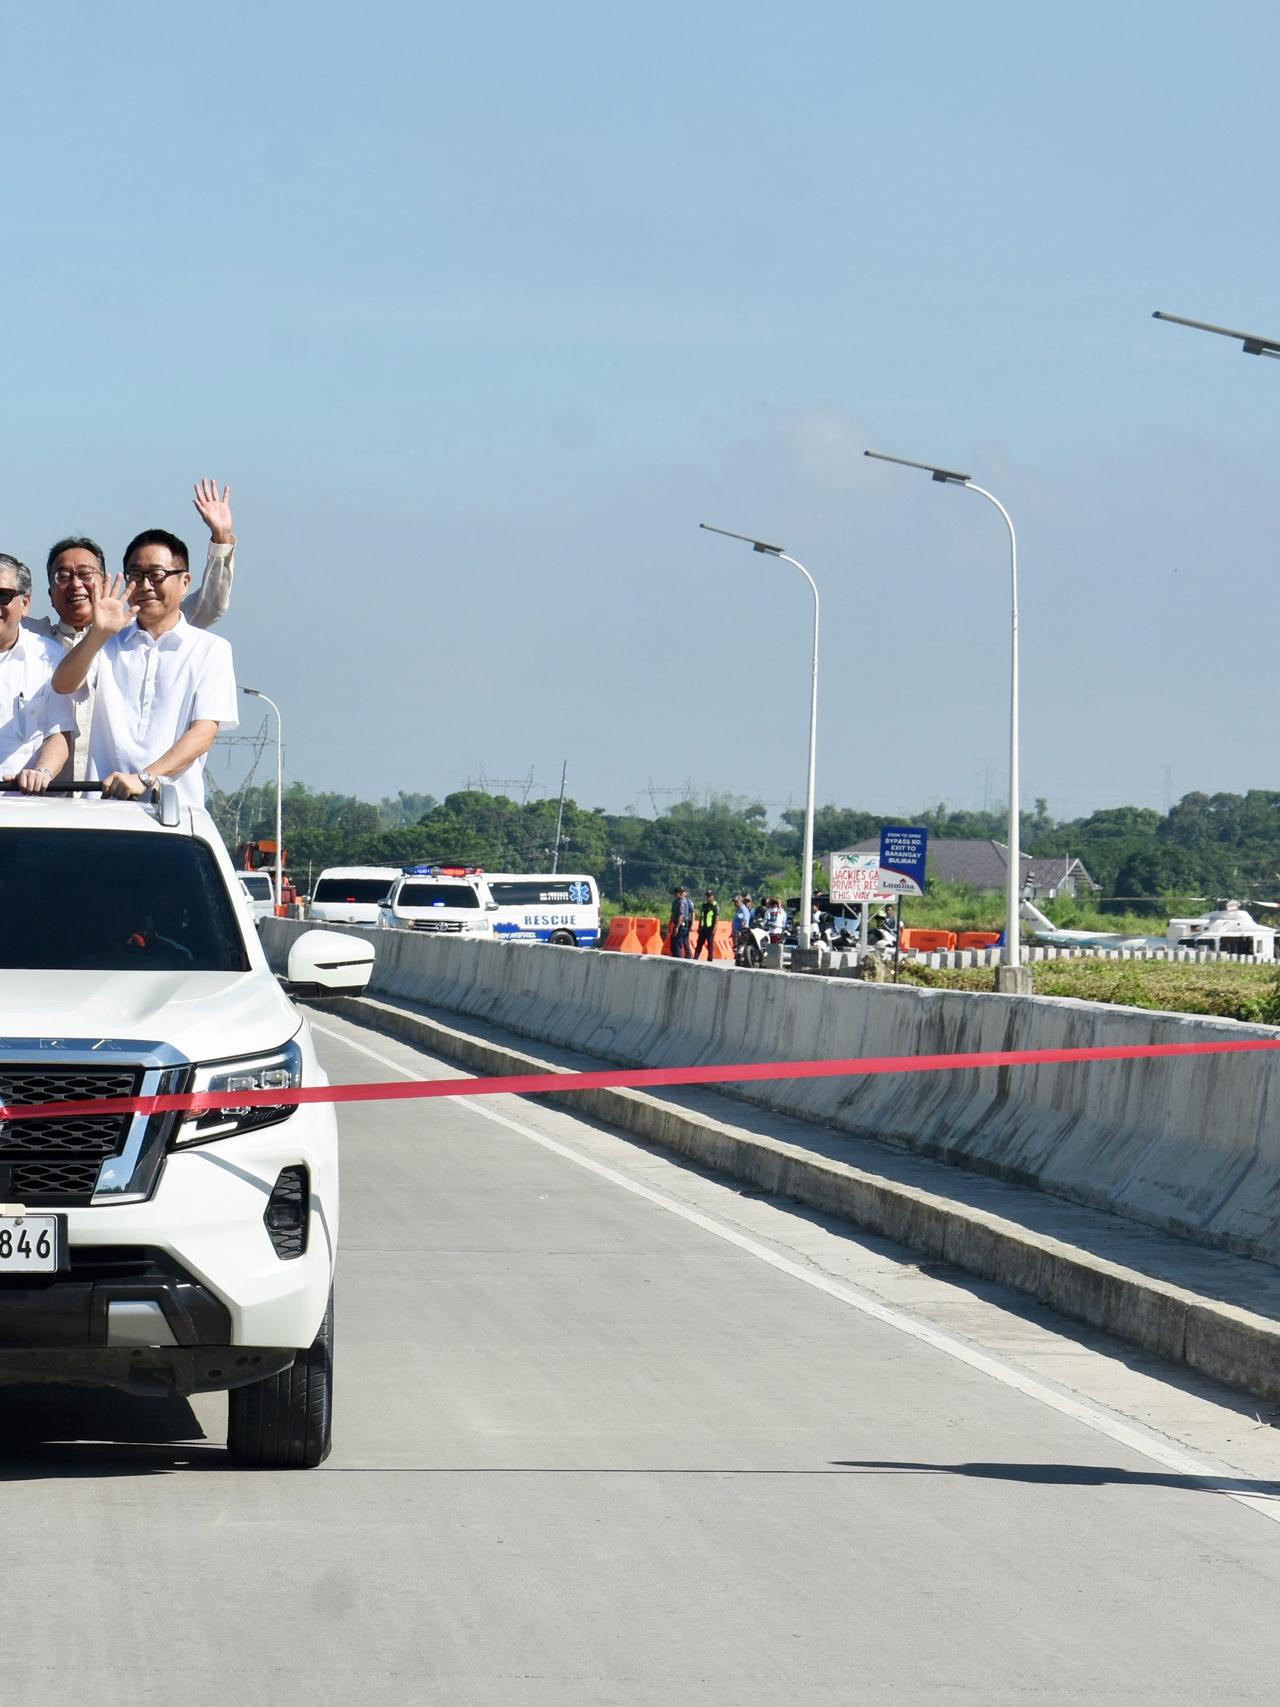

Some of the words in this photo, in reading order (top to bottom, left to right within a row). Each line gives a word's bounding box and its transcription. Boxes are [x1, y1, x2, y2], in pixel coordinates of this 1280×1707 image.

[885, 850, 921, 858] BARANGAY
[834, 870, 866, 880] JACKIES
[832, 880, 860, 890] PRIVATE
[883, 881, 914, 889] Lumina
[832, 890, 850, 899] THIS
[853, 891, 870, 899] WAY
[524, 915, 576, 925] RESCUE
